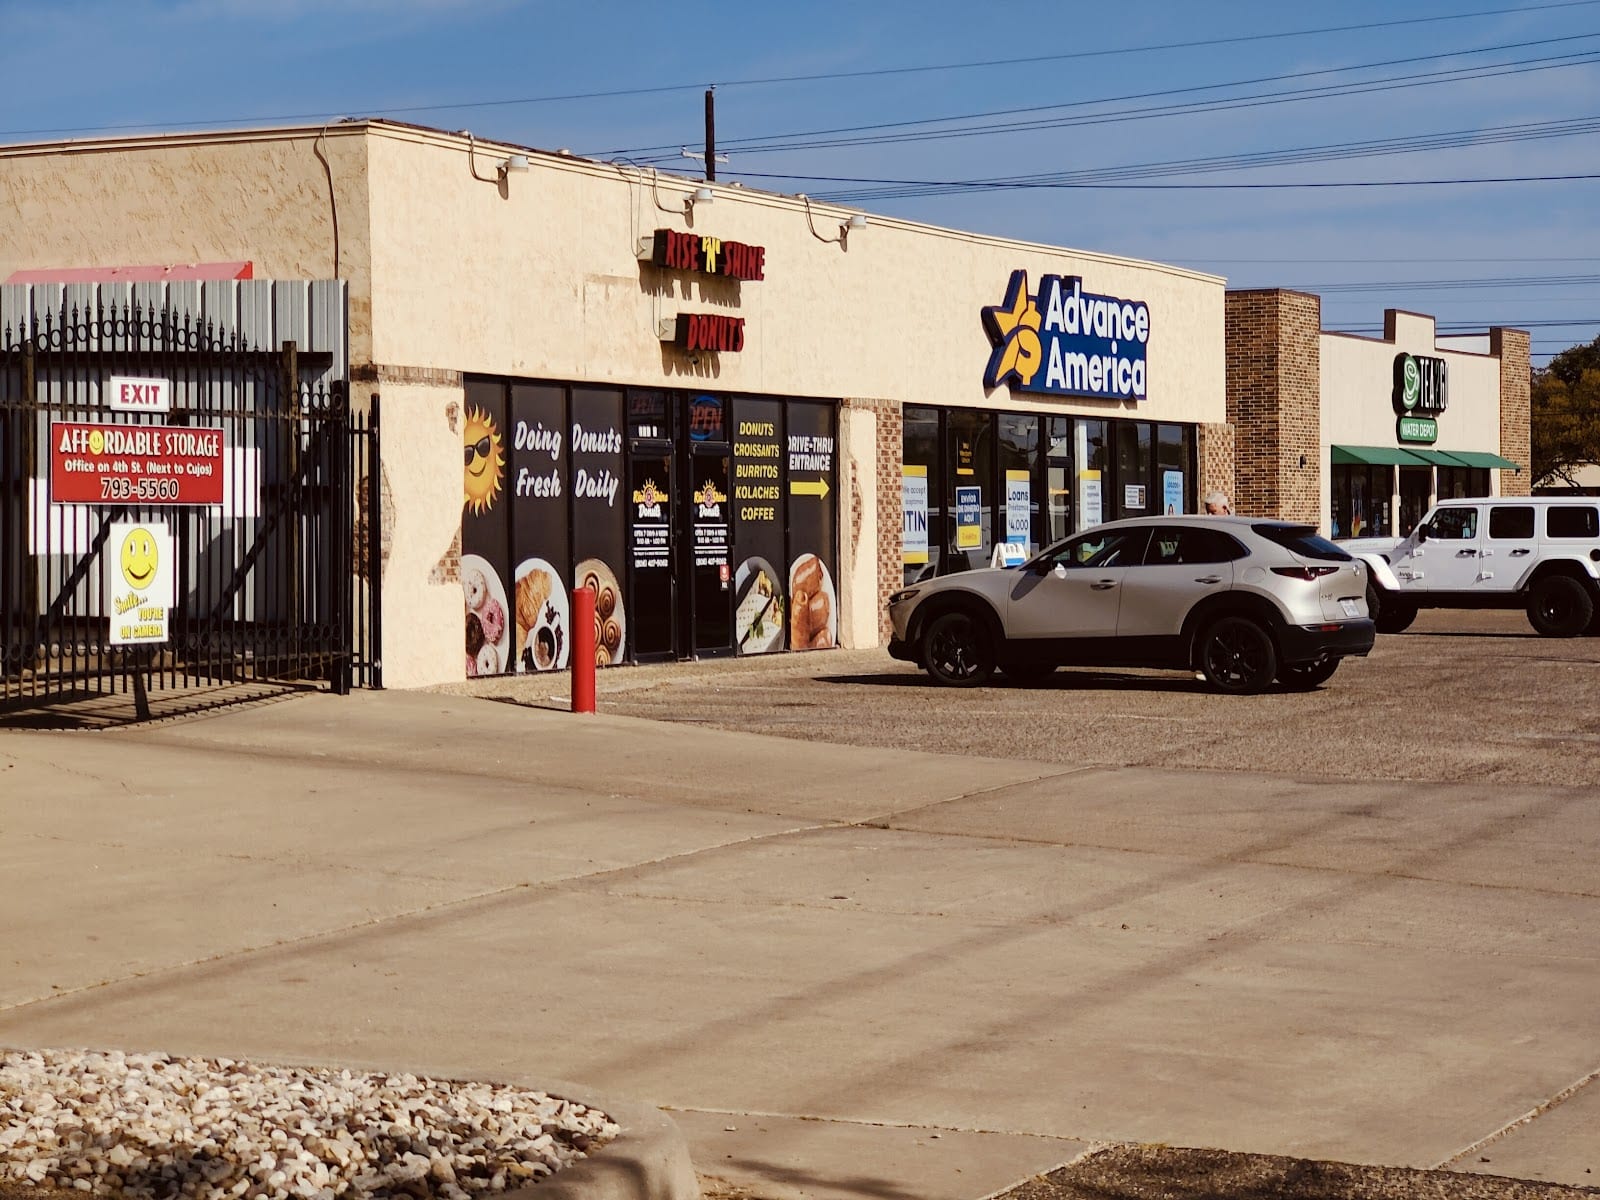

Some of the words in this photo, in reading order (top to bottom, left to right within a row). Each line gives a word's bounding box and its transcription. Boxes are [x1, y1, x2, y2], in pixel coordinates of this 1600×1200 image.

[665, 229, 698, 271] RISE
[724, 241, 765, 281] SHINE
[1045, 280, 1148, 343] Advance
[687, 314, 745, 352] DONUTS
[1046, 337, 1145, 396] America
[120, 384, 161, 405] EXIT
[740, 422, 774, 436] DONUTS
[1402, 423, 1419, 437] WATER
[1420, 424, 1435, 437] DEPOT
[59, 428, 161, 456] AFFORDABLE
[165, 433, 219, 457] STORAGE
[514, 421, 562, 460] Doing
[573, 423, 622, 453] Donuts
[733, 443, 779, 457] CROISSANTS
[64, 459, 95, 473] Office
[97, 462, 110, 473] on
[113, 460, 128, 473] 4th
[131, 461, 143, 474] St.
[146, 461, 171, 475] (Next
[174, 463, 184, 475] to
[186, 462, 213, 477] Cujos)
[736, 465, 778, 478] BURRITOS
[789, 454, 830, 471] ENTRANCE
[101, 477, 179, 500] 793-5560
[516, 467, 562, 497] Fresh
[575, 469, 619, 507] Daily
[735, 486, 779, 500] KOLACHES
[1008, 487, 1029, 501] Loans
[741, 507, 774, 520] COFFEE
[120, 625, 131, 639] ON
[132, 624, 163, 639] CAMERA
